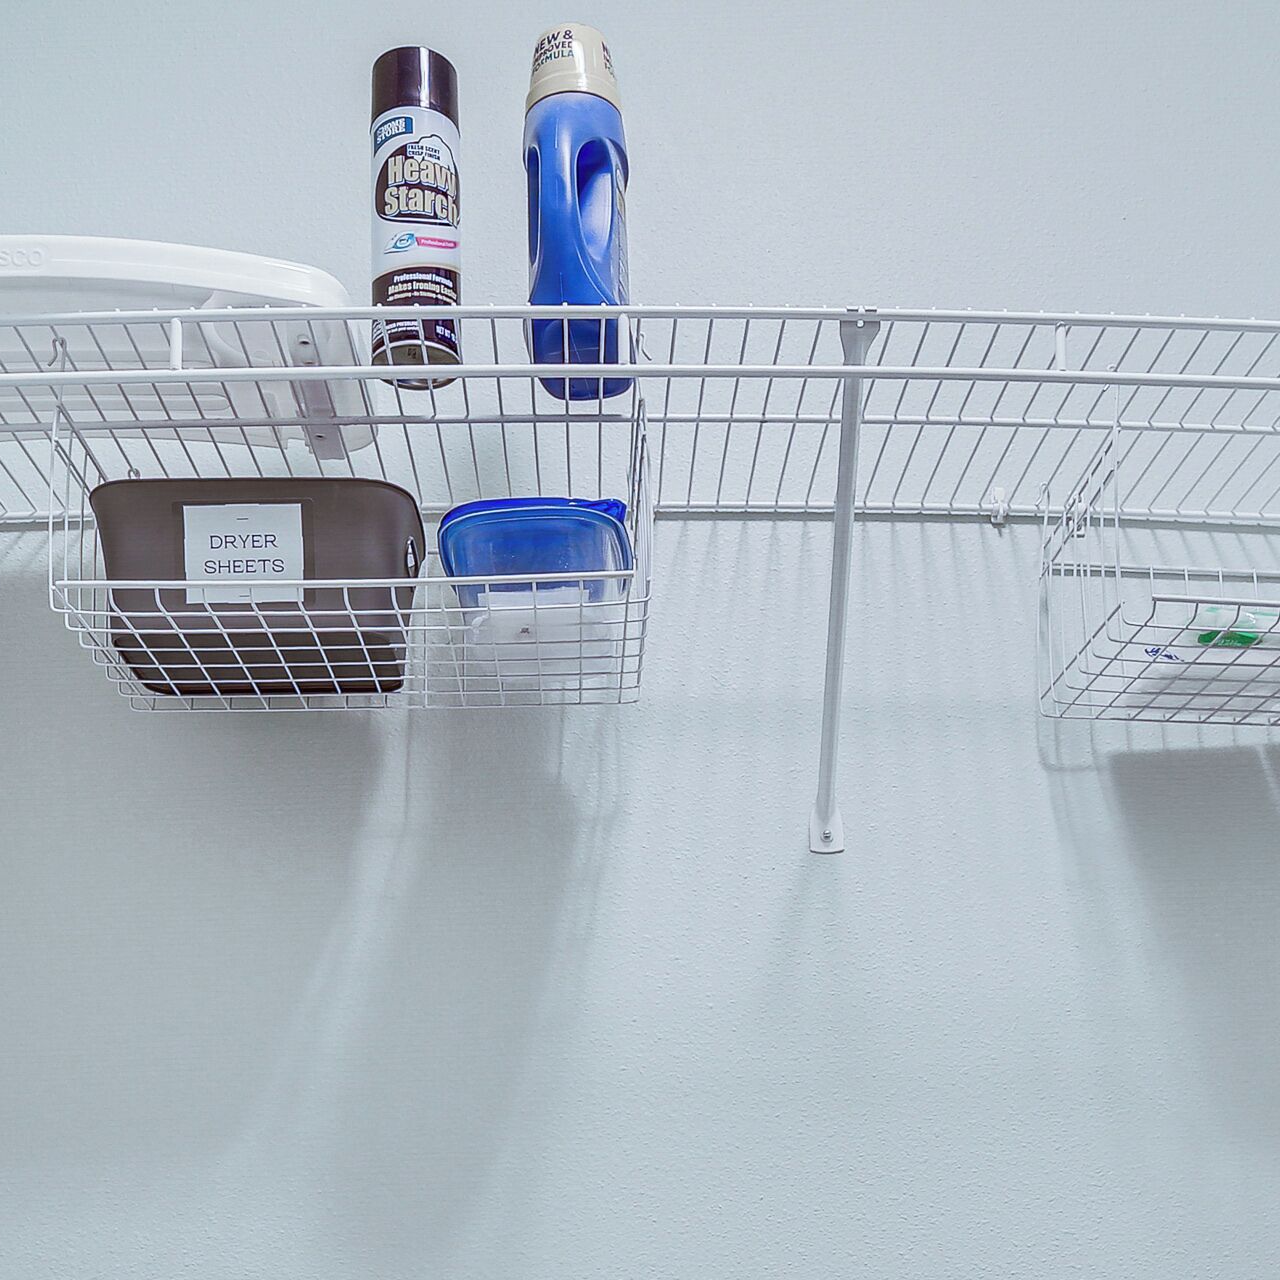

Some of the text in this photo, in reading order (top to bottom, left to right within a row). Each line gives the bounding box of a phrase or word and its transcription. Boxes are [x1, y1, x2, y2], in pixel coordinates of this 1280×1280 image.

[563, 29, 573, 39] &
[376, 124, 406, 144] STORE
[387, 155, 457, 198] Heavy
[384, 185, 459, 228] Starch
[388, 282, 412, 296] Makes
[209, 534, 278, 550] DRYER
[204, 558, 285, 575] SHEETS
